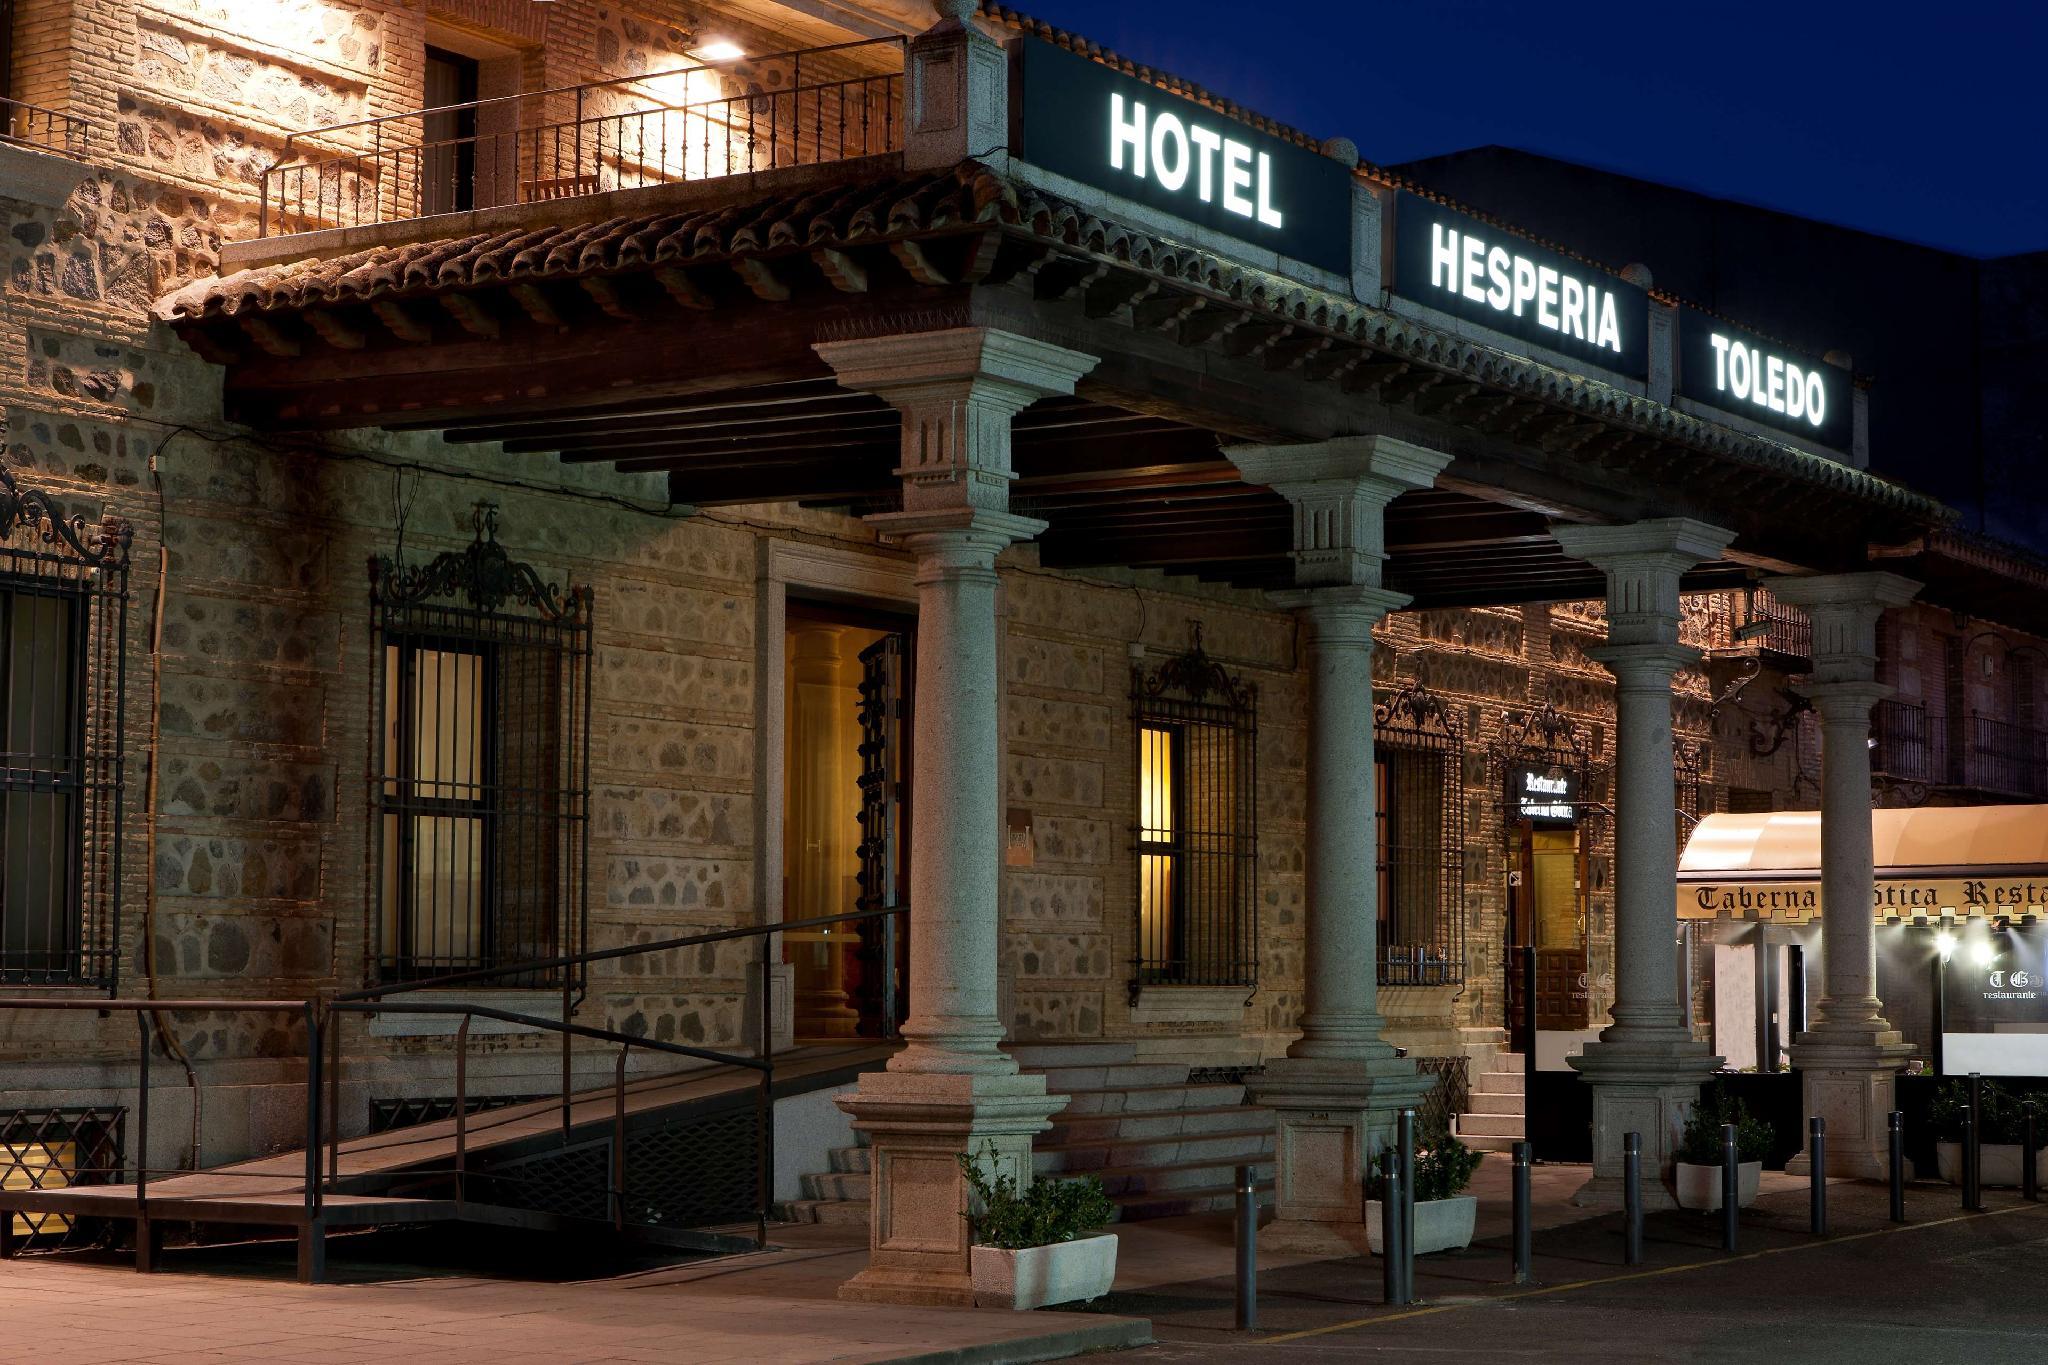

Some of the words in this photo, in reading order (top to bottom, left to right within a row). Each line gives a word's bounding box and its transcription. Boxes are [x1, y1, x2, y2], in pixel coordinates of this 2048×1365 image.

[1110, 92, 1283, 229] HOTEL
[1431, 223, 1621, 353] HESPERIA
[1711, 333, 1826, 426] TOLEDO
[1695, 886, 1816, 910] Taberna
[1874, 883, 1938, 906] ótica
[1983, 991, 2036, 999] restaurante
